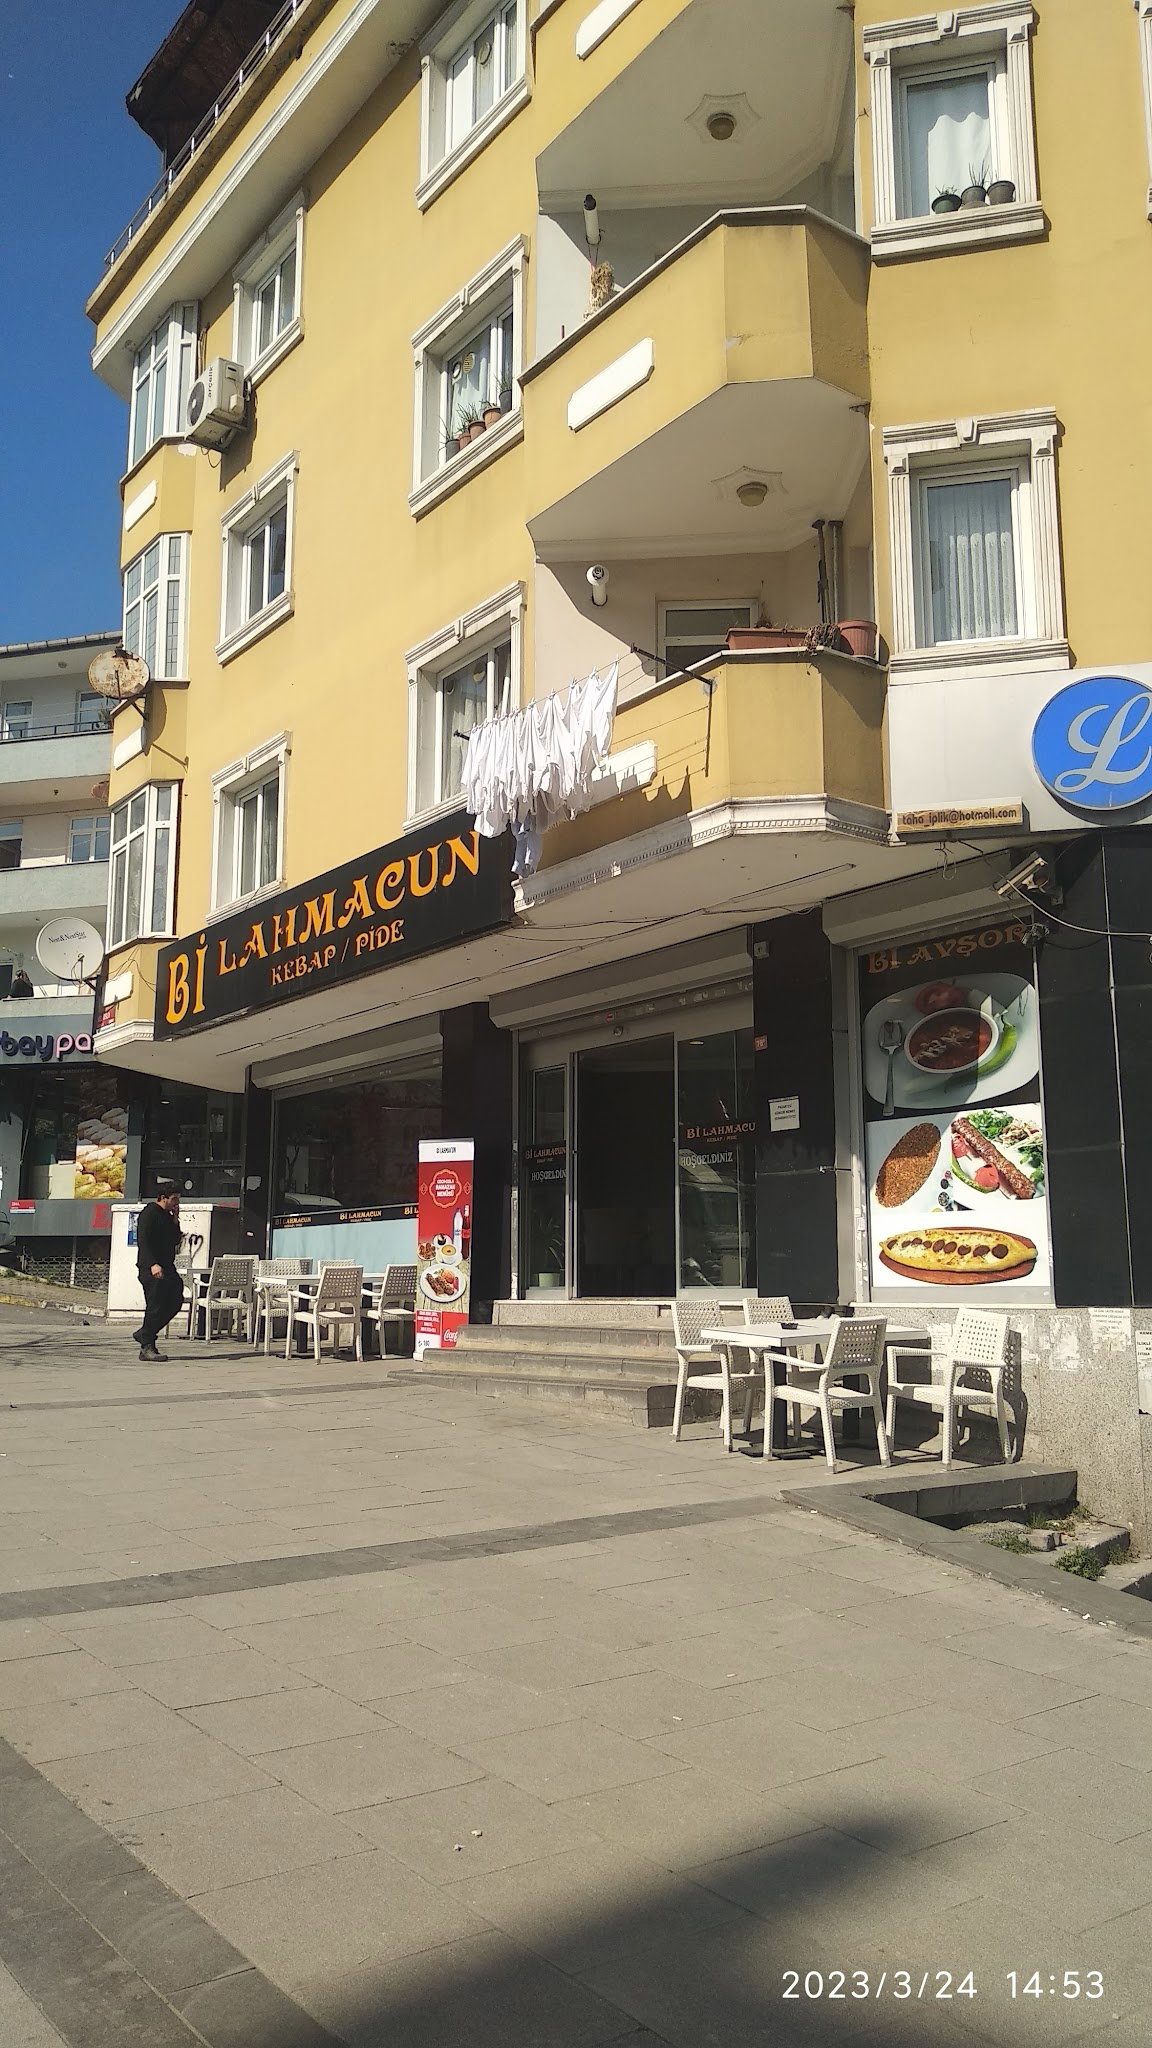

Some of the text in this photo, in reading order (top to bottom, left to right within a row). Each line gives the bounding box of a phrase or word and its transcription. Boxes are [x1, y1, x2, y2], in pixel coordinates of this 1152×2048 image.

[1054, 691, 1152, 794] L
[902, 808, 1017, 827] taha_iplik@hotmail.com
[165, 831, 481, 1025] Bİ LAHMACUN
[270, 945, 337, 987] KEBAP
[355, 919, 405, 957] PİDE
